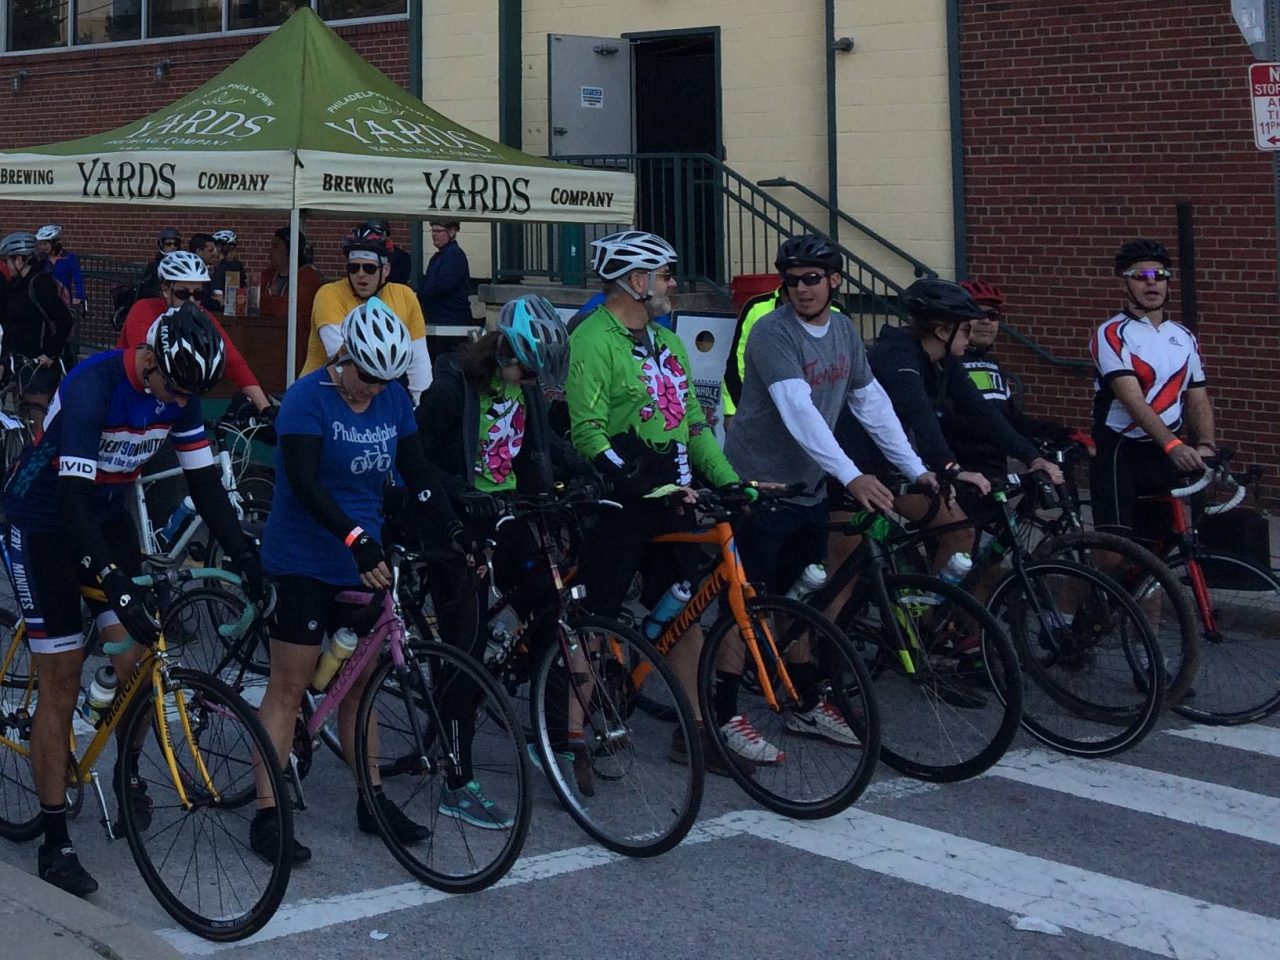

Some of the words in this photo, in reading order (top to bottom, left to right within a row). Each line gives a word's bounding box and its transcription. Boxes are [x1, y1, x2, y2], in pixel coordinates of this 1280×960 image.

[323, 117, 491, 153] YARDS
[0, 168, 54, 185] BREWING
[77, 157, 177, 200] YARDS
[198, 171, 270, 191] COMPANY
[322, 173, 394, 195] BREWING
[422, 168, 532, 215] YARDS
[551, 187, 615, 207] COMPANY
[12, 562, 34, 610] MINUTES
